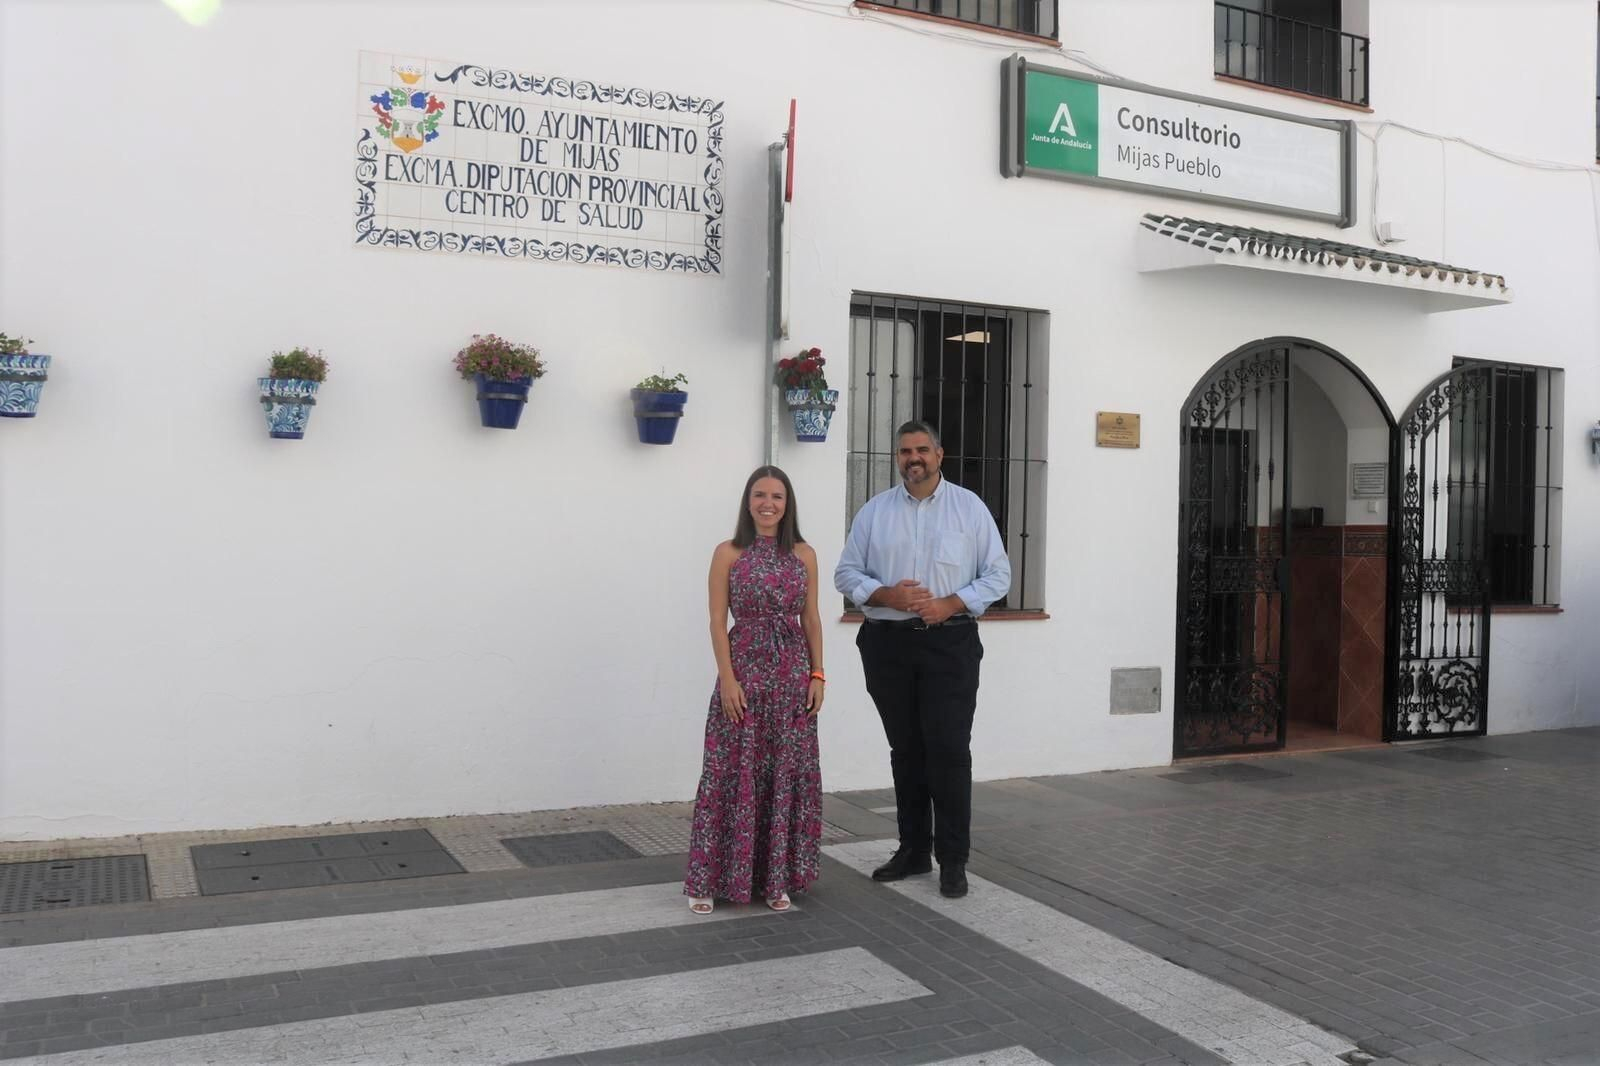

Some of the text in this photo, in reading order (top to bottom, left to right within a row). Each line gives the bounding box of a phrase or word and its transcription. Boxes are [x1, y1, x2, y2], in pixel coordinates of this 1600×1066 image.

[453, 100, 697, 155] EXCMO. AYUNTAMIENTO
[1031, 133, 1050, 143] Junta
[1051, 136, 1060, 145] de
[1117, 107, 1242, 150] Consultorio
[520, 138, 620, 172] DE MIJAS
[1117, 144, 1222, 179] Mijas Pueblo
[384, 154, 701, 213] EXCMA. DIPUTACION PROVINCIAL
[445, 189, 644, 231] CENTRO DE SALUD
